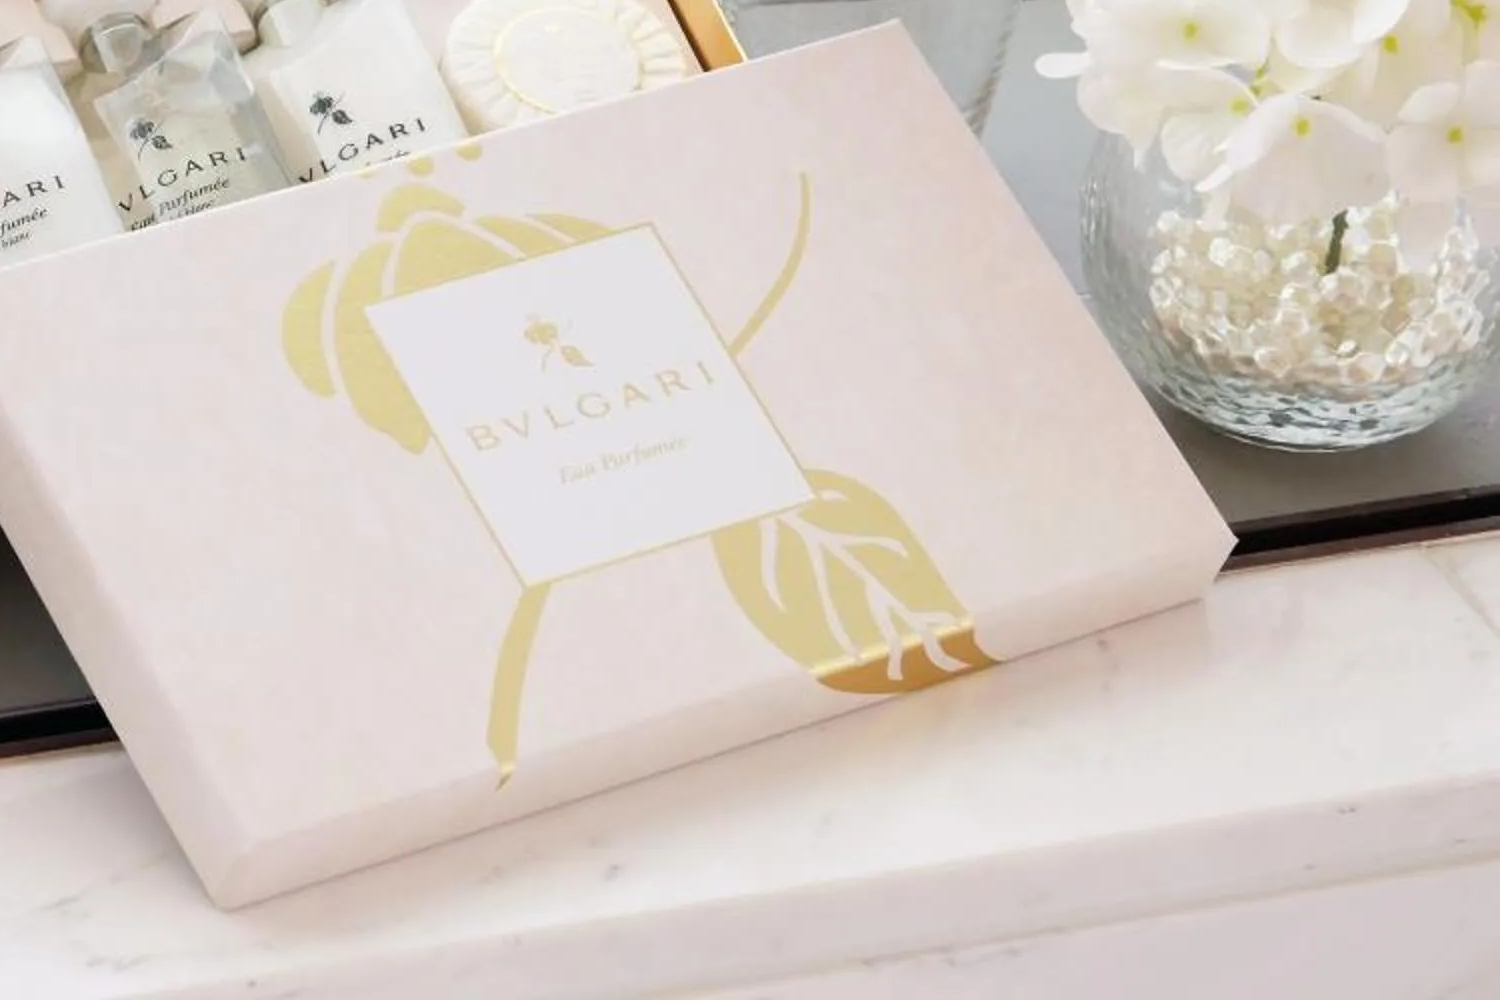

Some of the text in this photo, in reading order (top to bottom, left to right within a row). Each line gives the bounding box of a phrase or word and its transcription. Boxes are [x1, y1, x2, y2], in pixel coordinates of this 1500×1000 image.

[118, 146, 246, 212] VLGARI
[298, 117, 426, 184] VLGARI
[465, 359, 717, 452] BVLGARI
